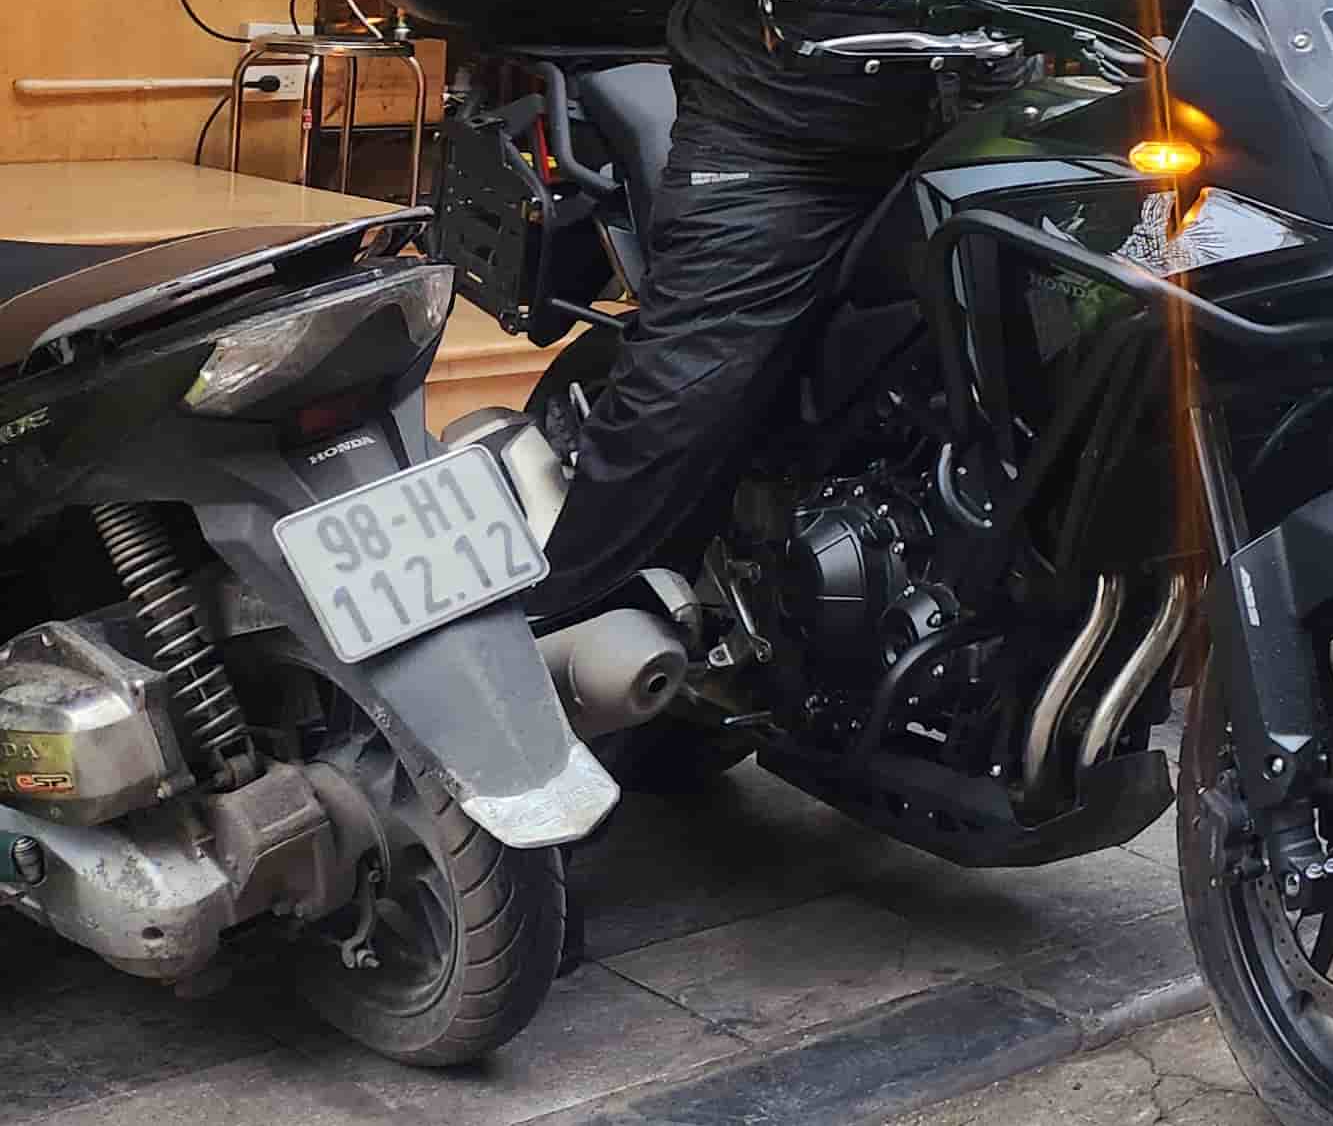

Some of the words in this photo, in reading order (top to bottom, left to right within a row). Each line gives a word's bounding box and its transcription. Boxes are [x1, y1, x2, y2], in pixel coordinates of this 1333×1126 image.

[307, 435, 377, 465] HONDA
[315, 467, 477, 573] 98-H1
[332, 520, 532, 643] 112.12
